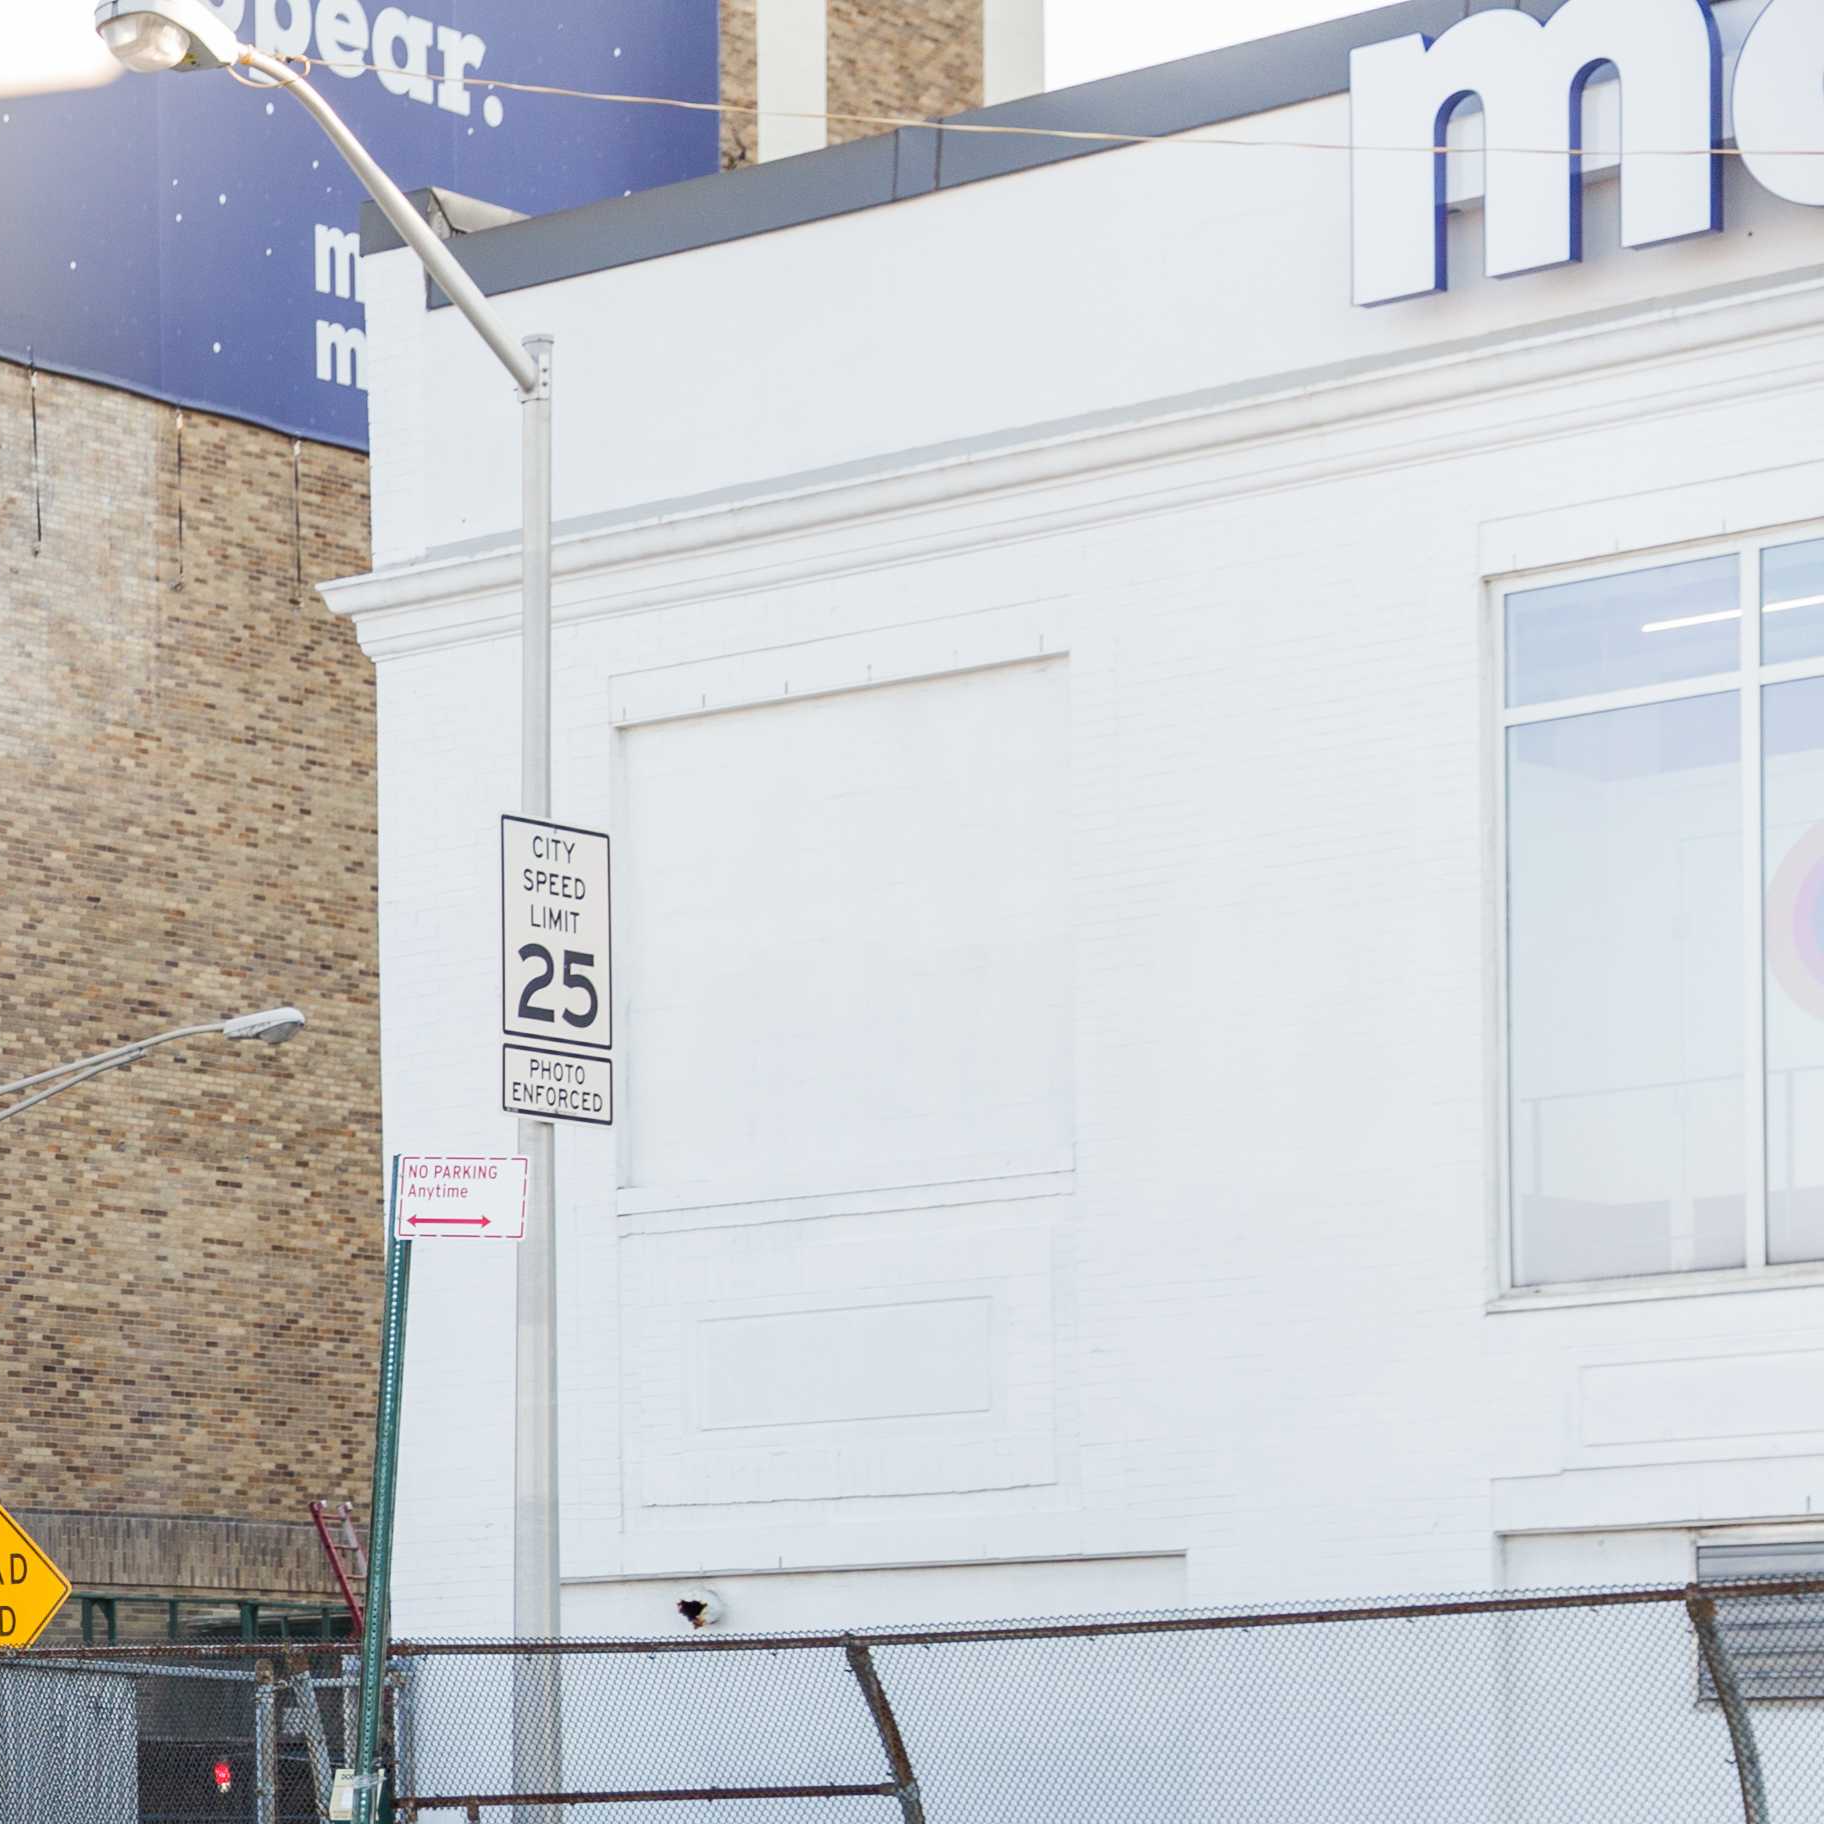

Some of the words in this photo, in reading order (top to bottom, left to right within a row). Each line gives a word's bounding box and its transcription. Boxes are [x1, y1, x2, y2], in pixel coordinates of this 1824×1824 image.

[532, 836, 576, 864] CITY
[523, 868, 586, 901] SPEED
[530, 903, 581, 934] LIMIT
[517, 942, 599, 1029] 25
[529, 1058, 586, 1085] PHOTO
[512, 1081, 603, 1113] ENFORCED
[408, 1164, 429, 1179] NO
[434, 1164, 498, 1180] PARKING
[407, 1183, 469, 1200] Anytime
